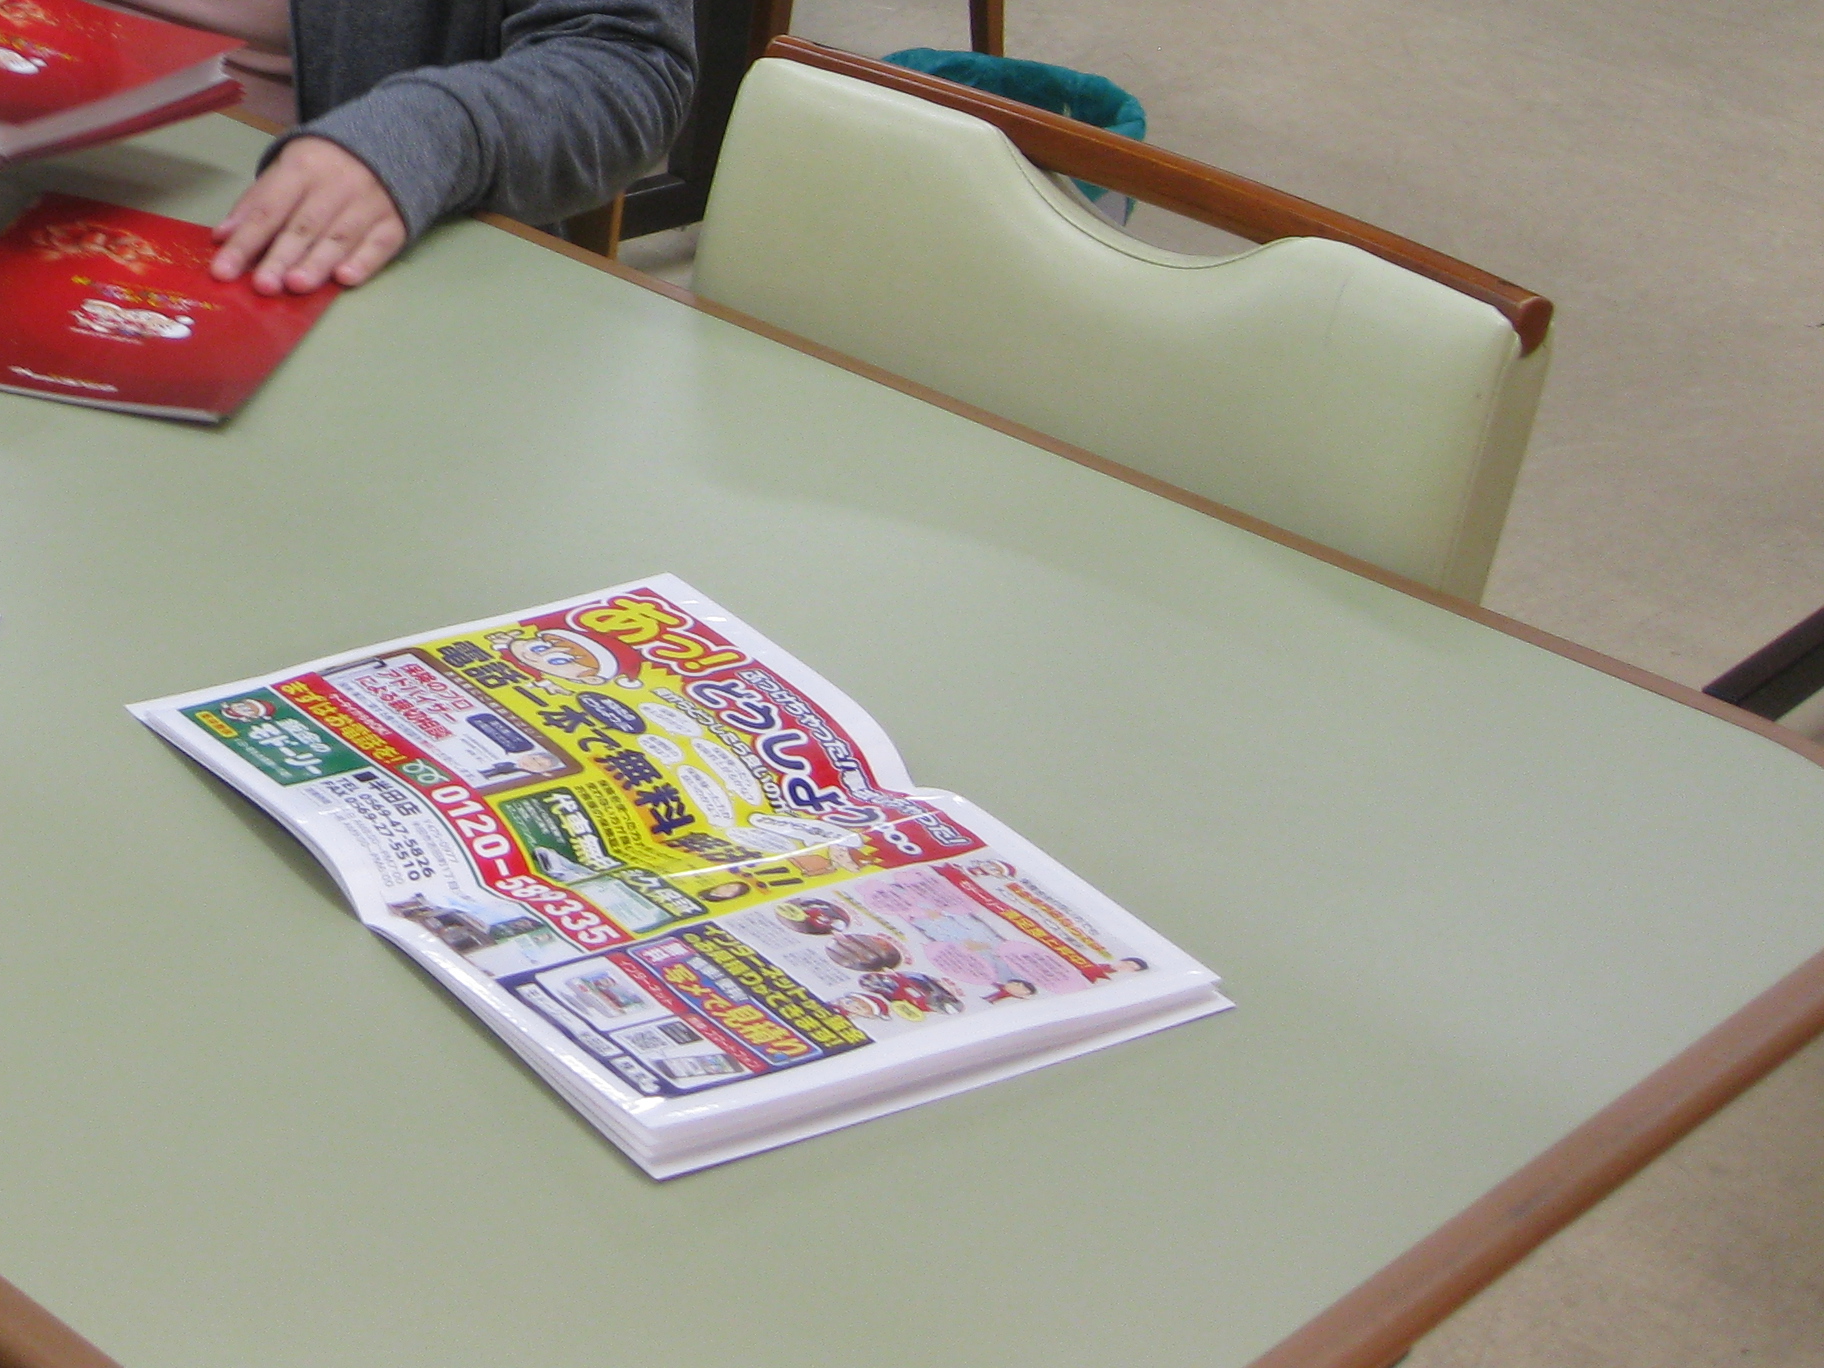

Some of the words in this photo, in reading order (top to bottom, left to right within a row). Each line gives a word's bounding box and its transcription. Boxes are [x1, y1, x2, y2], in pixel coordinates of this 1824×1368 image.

[578, 598, 742, 671] あっ!
[278, 680, 408, 764] まずはお電話を!
[354, 675, 454, 740] による親切相談
[377, 668, 462, 722] アドバイザー
[399, 661, 475, 710] 保険のプロ
[249, 721, 325, 776] モドーリー
[323, 780, 351, 805] FAX
[342, 796, 424, 880] 0569-27-5510
[336, 777, 362, 796] TEL
[356, 792, 437, 877] 0569-47-5826
[375, 779, 421, 816] 半田店
[430, 785, 624, 946] 0120-589335
[660, 961, 814, 1056] 写メで見積り
